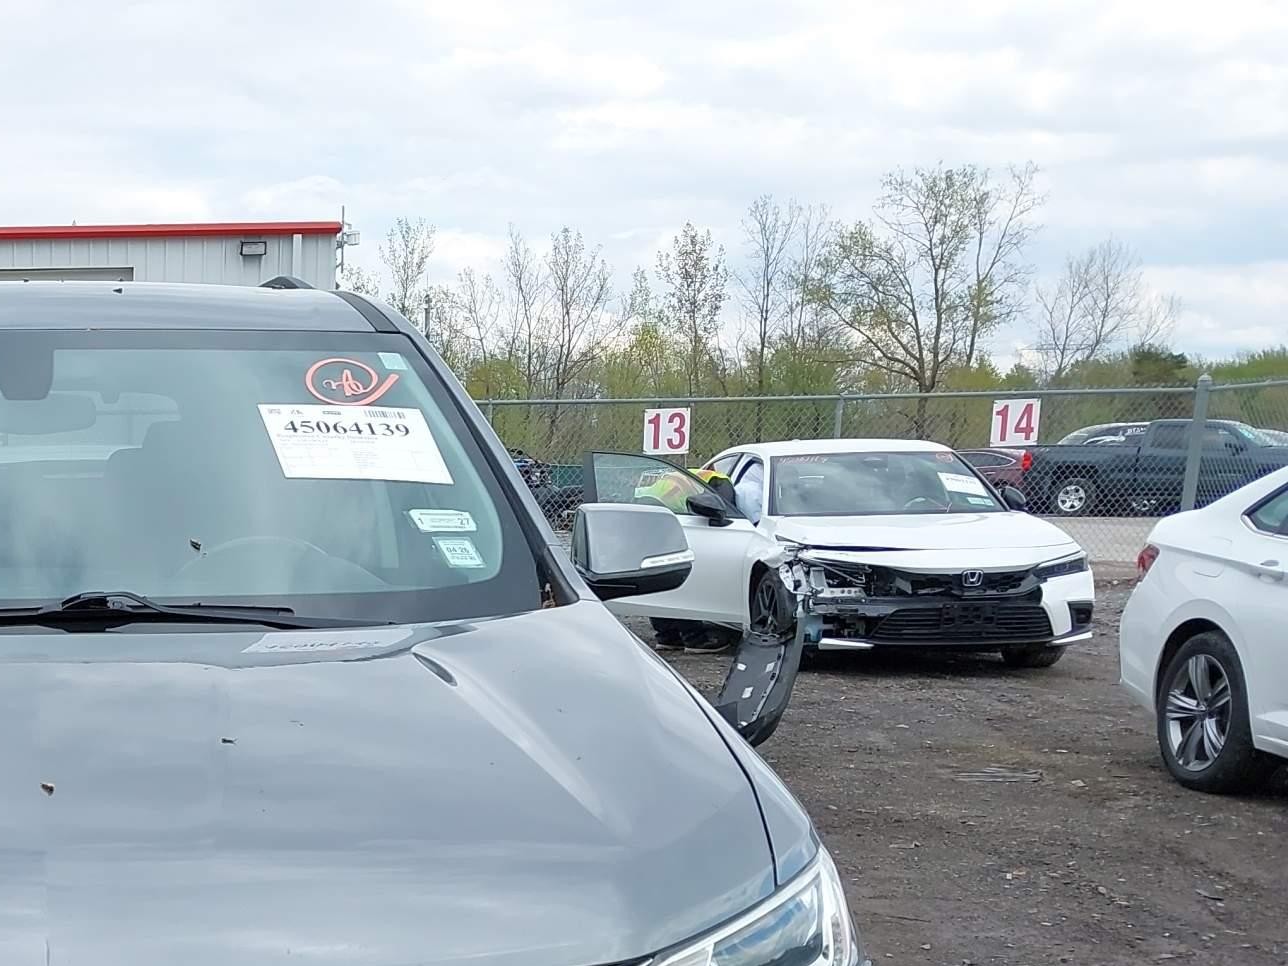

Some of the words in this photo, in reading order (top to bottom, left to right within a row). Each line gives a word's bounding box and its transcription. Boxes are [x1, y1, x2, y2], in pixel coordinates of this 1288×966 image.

[283, 419, 410, 438] 45064139
[647, 412, 686, 450] 13
[995, 403, 1034, 442] 14
